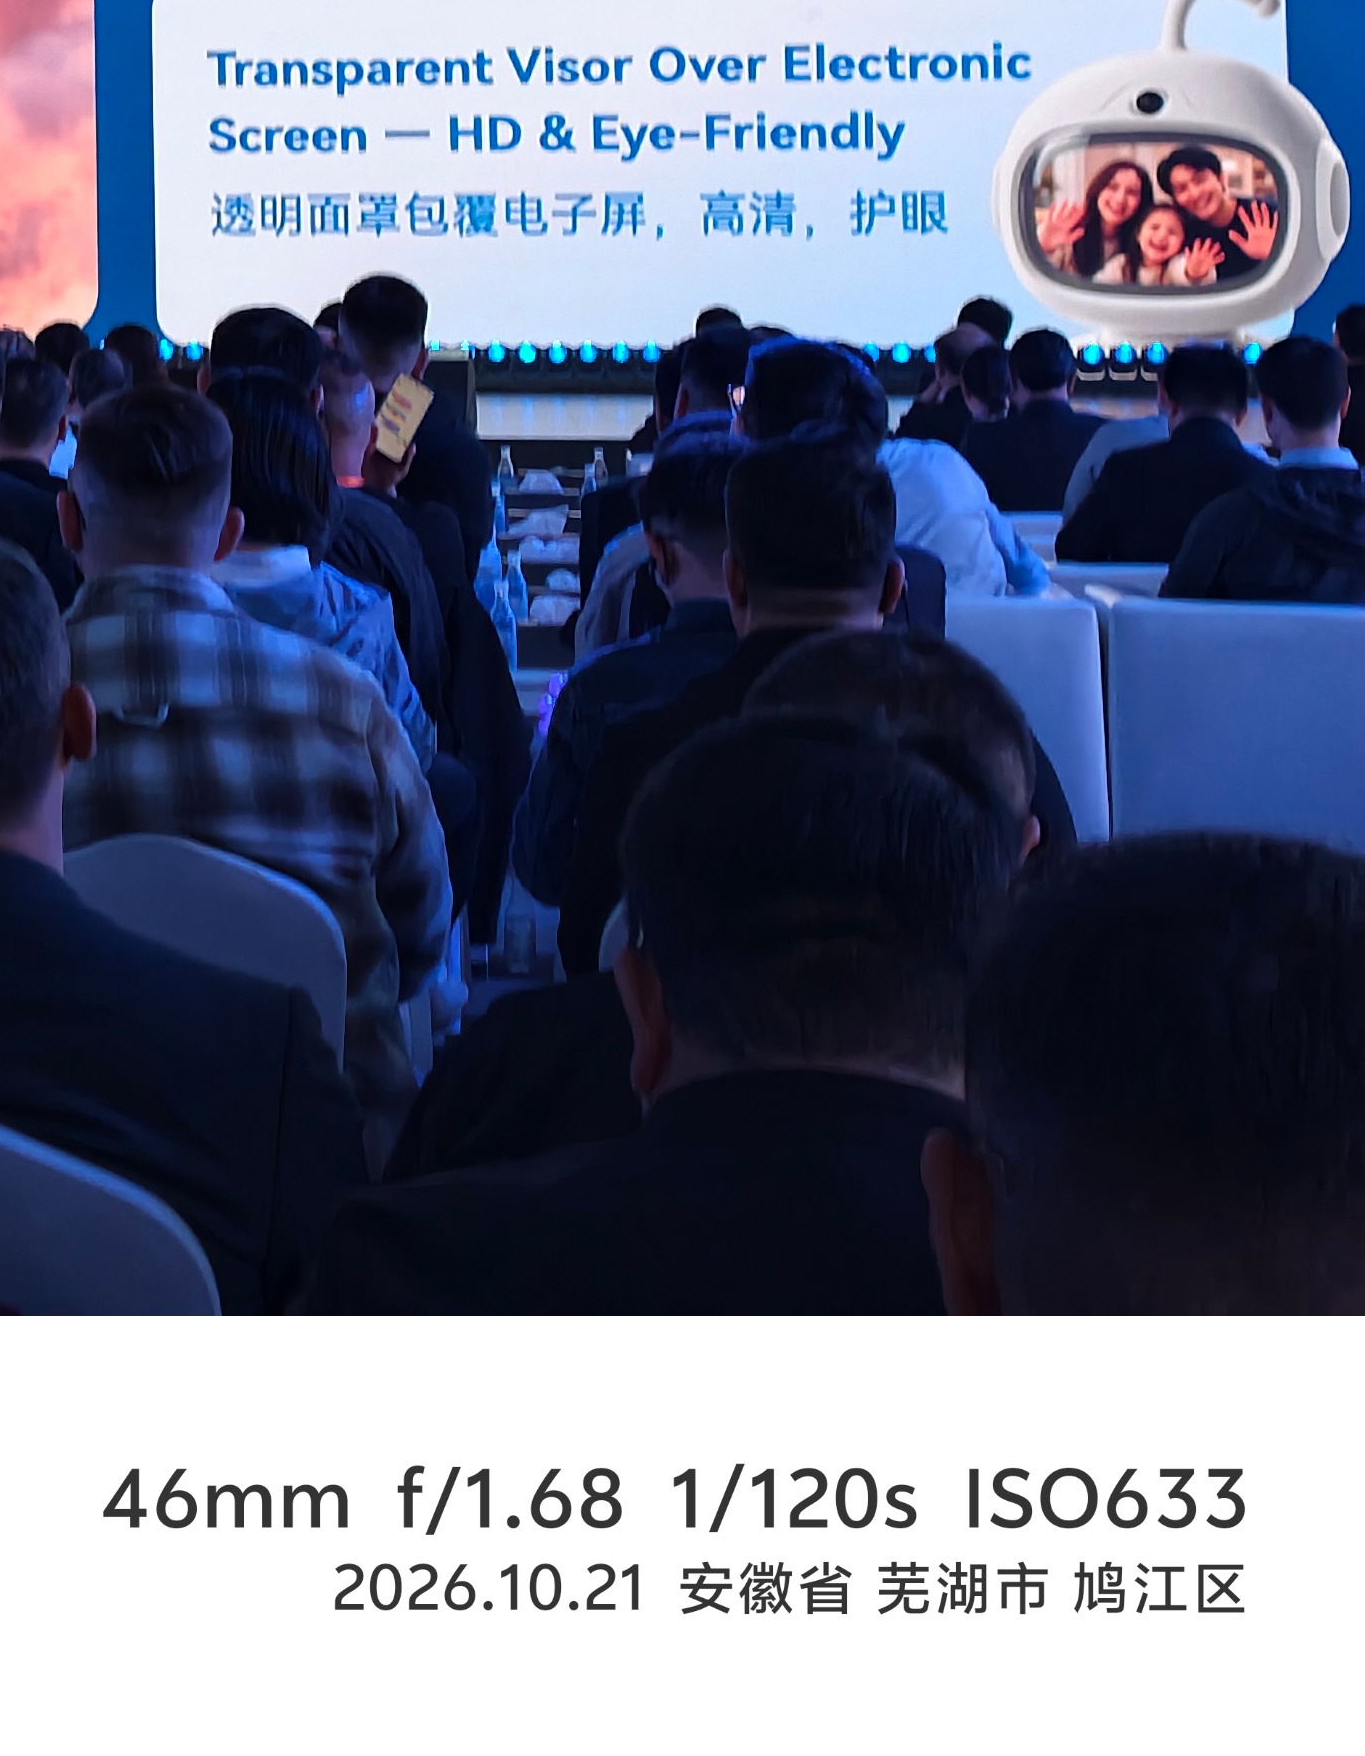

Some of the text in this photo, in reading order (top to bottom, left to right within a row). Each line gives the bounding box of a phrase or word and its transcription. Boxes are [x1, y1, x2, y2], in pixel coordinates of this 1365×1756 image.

[206, 40, 1032, 96] Transparent Visor Over Electronic
[209, 116, 367, 154] Screen
[449, 114, 522, 153] HD
[538, 112, 577, 153] &
[592, 109, 906, 162] Eye-Friendly
